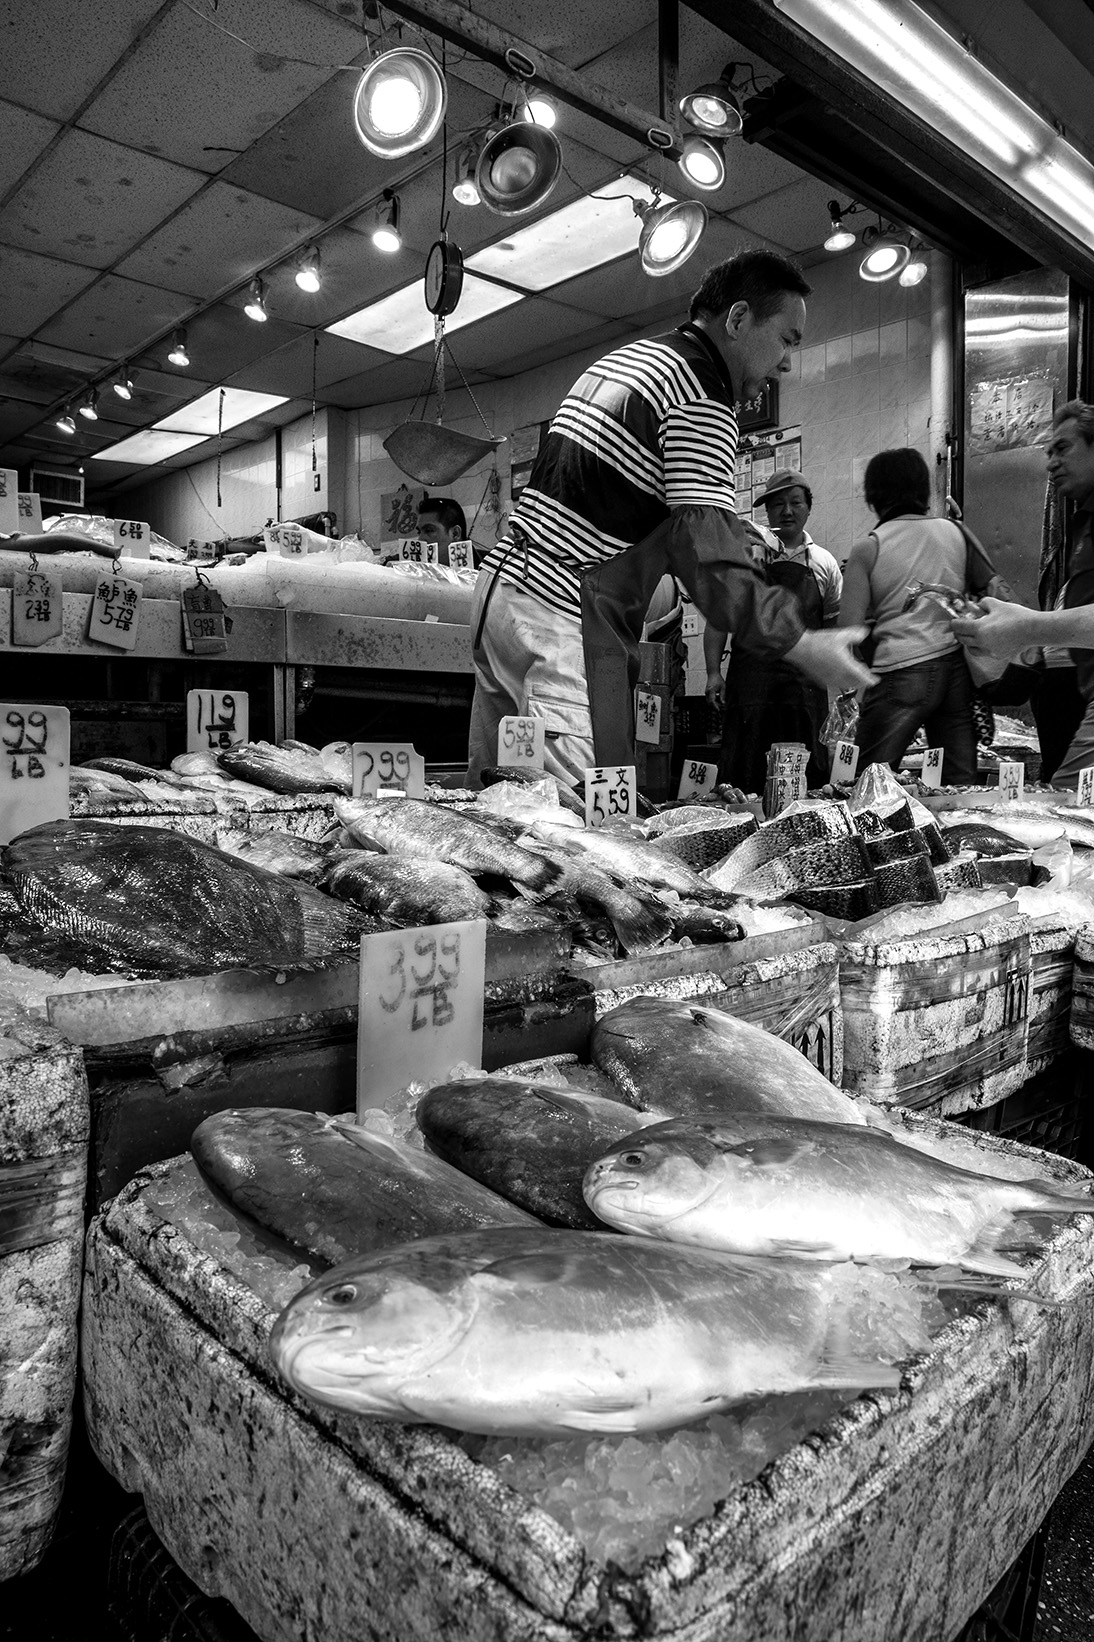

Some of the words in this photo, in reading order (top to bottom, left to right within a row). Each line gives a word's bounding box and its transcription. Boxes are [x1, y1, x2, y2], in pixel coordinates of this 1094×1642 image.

[208, 732, 232, 749] LB
[11, 756, 45, 779] LB
[591, 768, 629, 787] 三文
[411, 990, 455, 1031] LB
